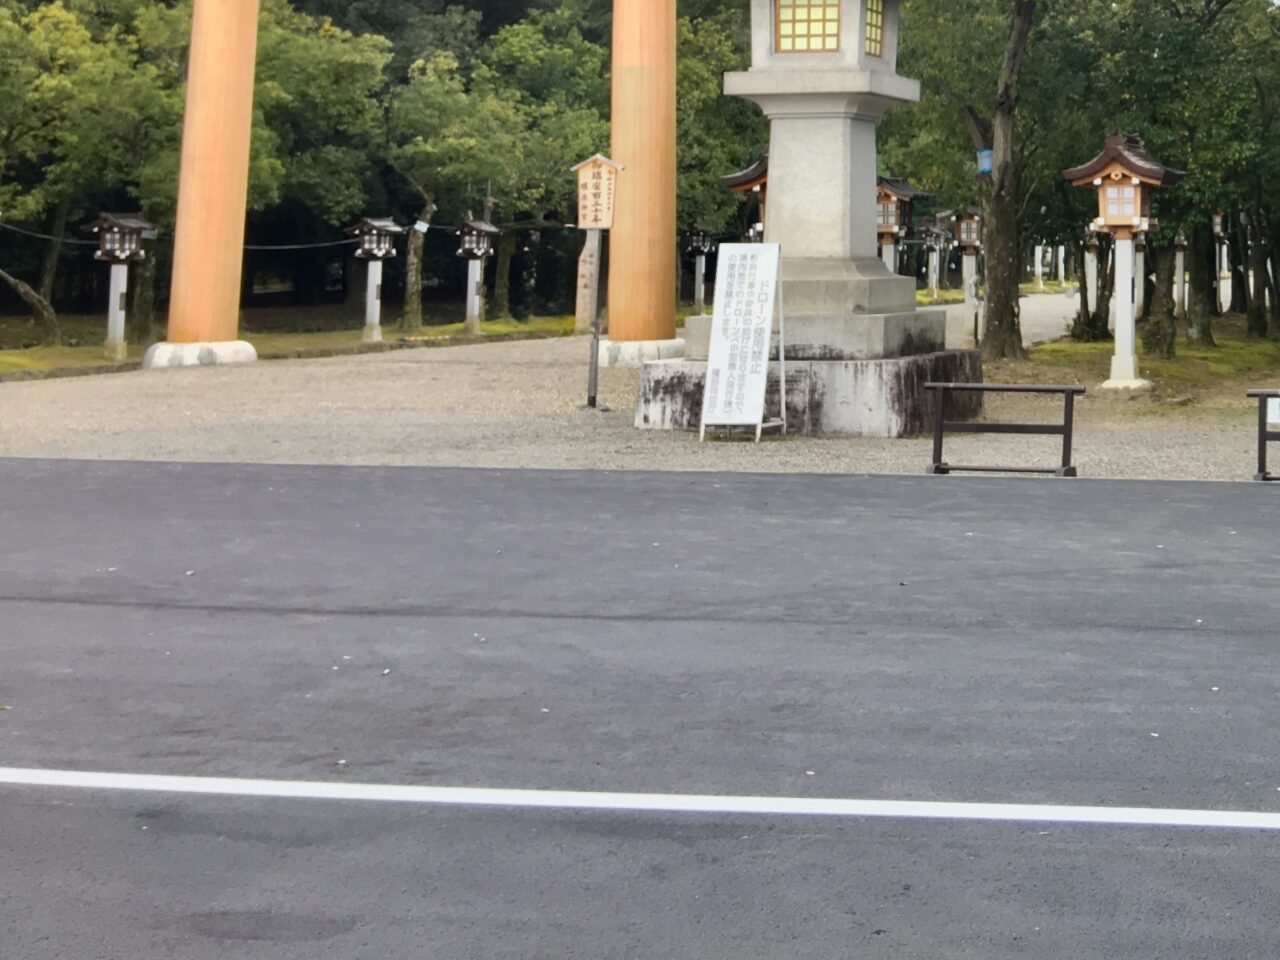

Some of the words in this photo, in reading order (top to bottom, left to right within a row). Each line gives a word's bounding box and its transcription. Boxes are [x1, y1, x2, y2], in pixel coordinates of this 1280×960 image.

[750, 280, 770, 374] ドローン使用禁止
